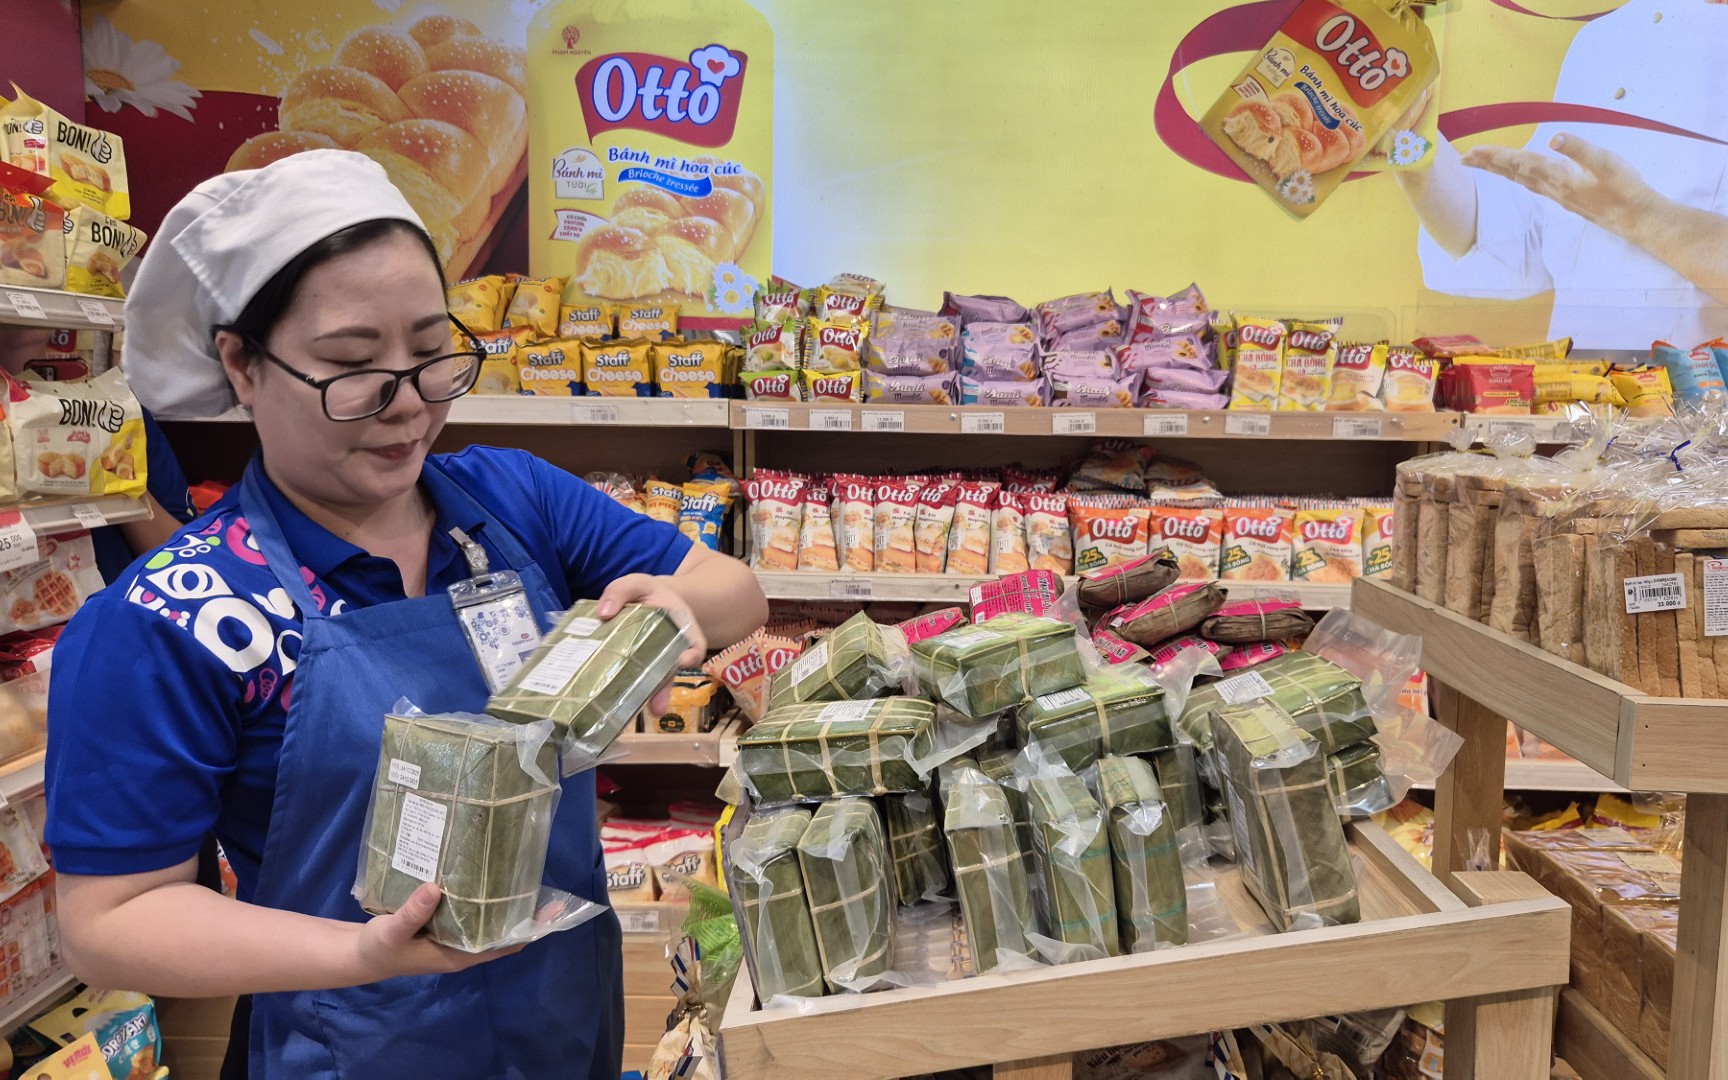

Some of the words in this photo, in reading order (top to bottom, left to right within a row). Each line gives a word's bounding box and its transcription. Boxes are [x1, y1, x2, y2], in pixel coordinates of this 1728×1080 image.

[1315, 14, 1386, 90] Otto
[592, 56, 720, 125] Otto
[1300, 65, 1323, 89] Bánh
[1320, 90, 1333, 103] mì
[1330, 101, 1346, 119] hoa
[1345, 116, 1363, 132] cúc
[57, 121, 91, 153] BON!
[552, 158, 585, 179] Bánh
[586, 168, 604, 179] mì
[609, 148, 650, 163] Bánh
[655, 157, 675, 170] mì
[681, 160, 710, 174] hoa
[714, 162, 741, 174] cúc
[628, 169, 665, 182] Brioche
[666, 178, 699, 193] tressée
[91, 221, 125, 251] BON!
[831, 295, 860, 311] Otto
[569, 308, 600, 322] Staff
[631, 308, 664, 320] Staff
[560, 322, 610, 335] Cheese
[621, 320, 671, 331] Cheese
[752, 327, 777, 345] Otto
[823, 327, 853, 346] Otto
[1242, 326, 1276, 345] Otto
[1291, 331, 1325, 350] Otto
[529, 350, 564, 367] Staff
[596, 351, 630, 367] Staff
[669, 350, 704, 367] Staff
[520, 367, 577, 380] Cheese
[586, 368, 643, 383] Cheese
[660, 368, 716, 383] Cheese
[754, 378, 786, 394] Otto
[816, 379, 847, 395] Otto
[59, 398, 97, 428] BON!
[761, 479, 798, 500] Otto
[877, 484, 914, 501] Otto
[920, 486, 942, 503] tto
[681, 493, 718, 512] Staff
[1030, 496, 1066, 512] Otto
[1092, 517, 1132, 538] Otto
[1164, 516, 1203, 538] Otto
[1236, 516, 1277, 537] Otto
[1305, 521, 1346, 539] Otto
[1090, 559, 1107, 568] BÔNG
[1232, 557, 1250, 568] BÔNG
[1306, 561, 1326, 572] BÔNG
[1366, 565, 1380, 575] CHÀ
[607, 866, 645, 887] Staff
